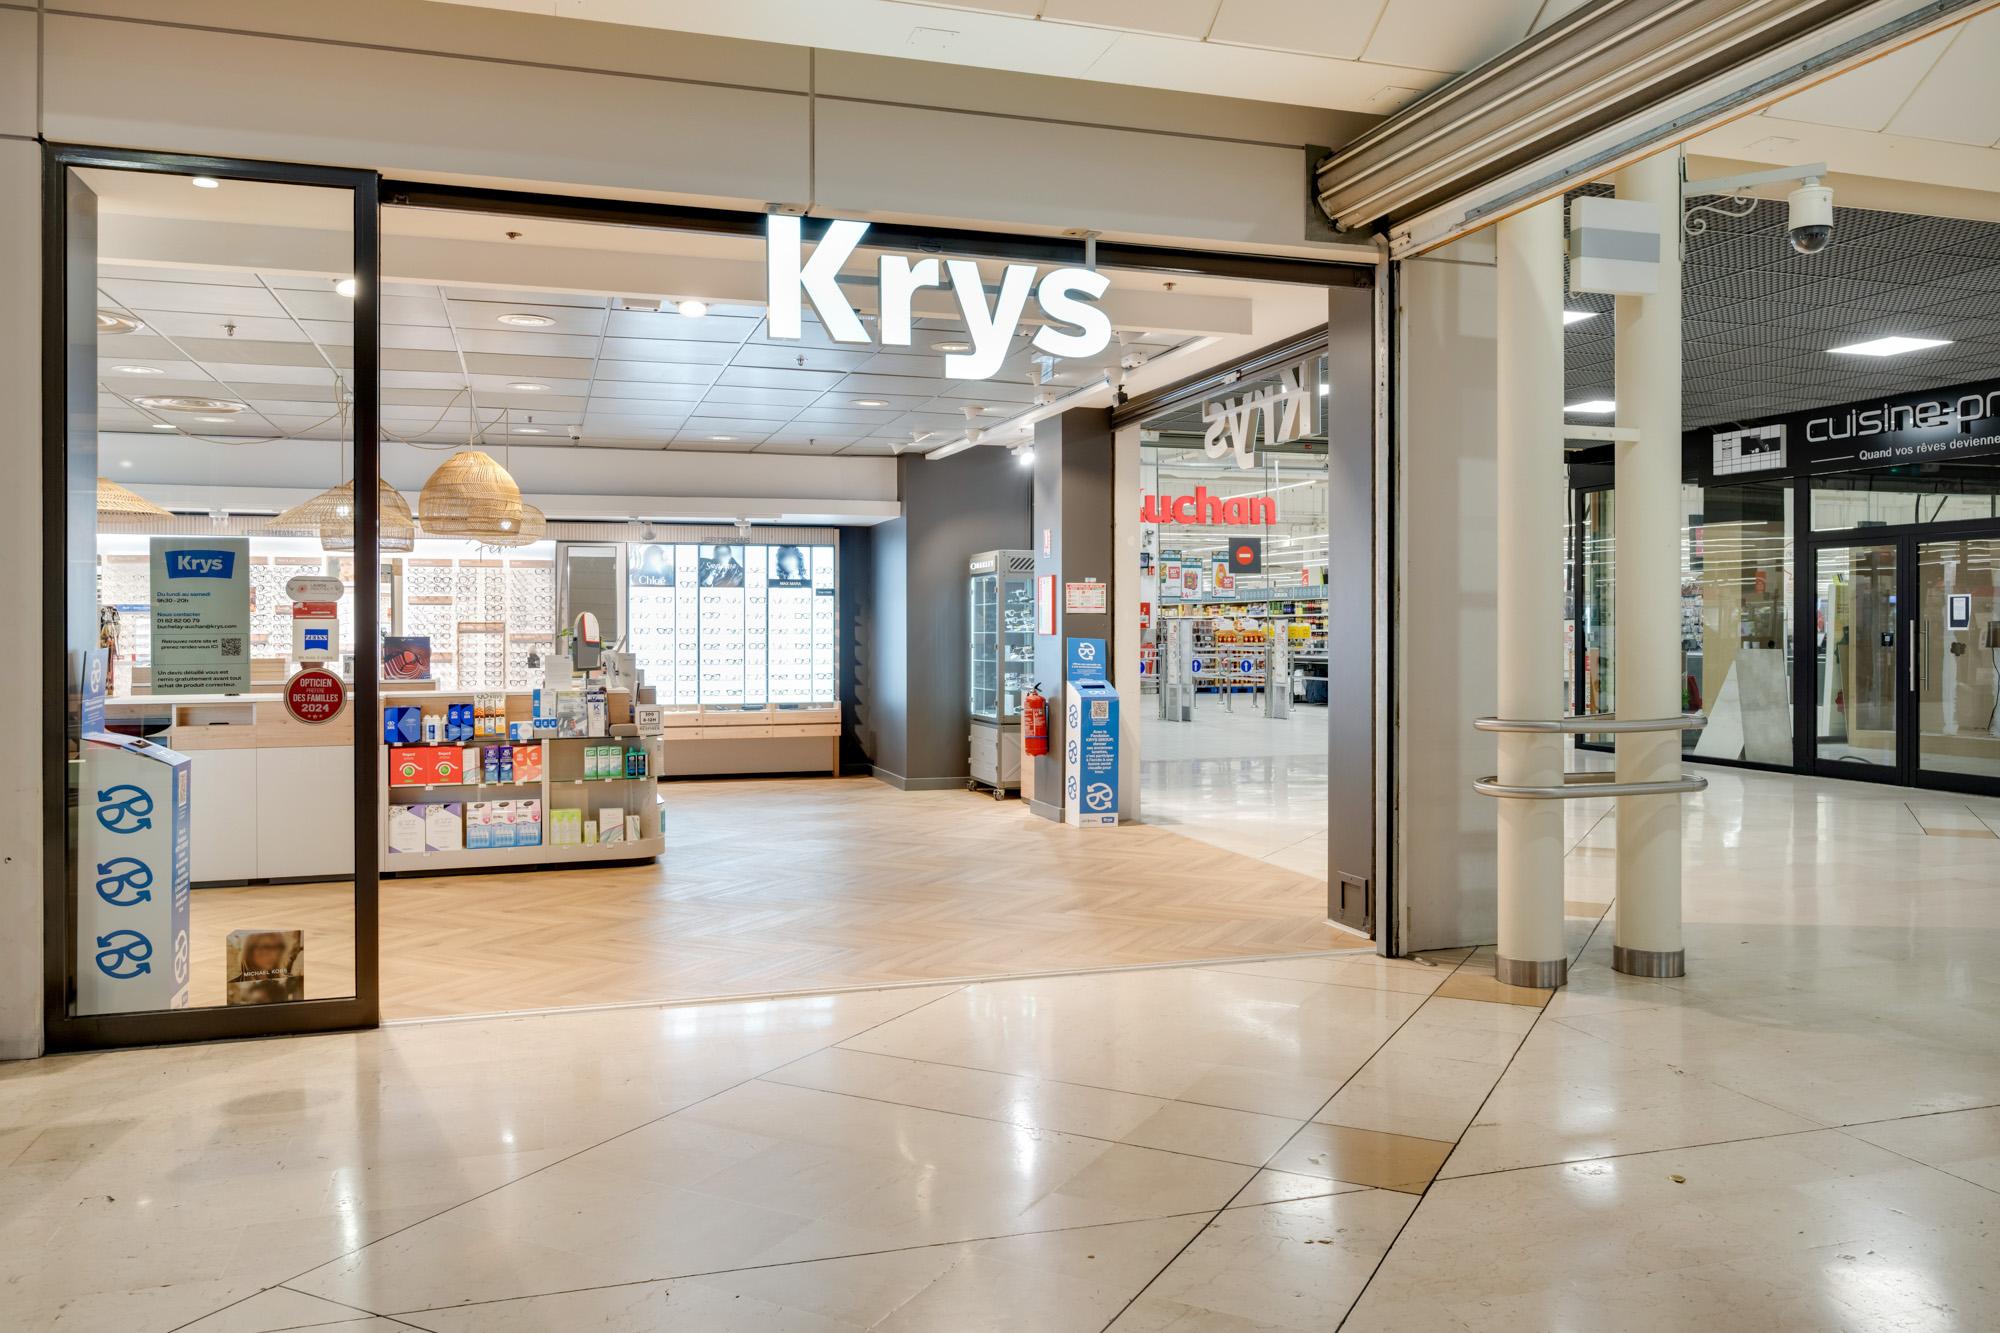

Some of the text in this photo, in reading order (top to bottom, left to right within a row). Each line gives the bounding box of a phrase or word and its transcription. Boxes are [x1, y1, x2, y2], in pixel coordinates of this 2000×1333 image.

[767, 215, 1112, 380] Krys
[1859, 447, 1892, 461] Quand
[1895, 445, 1913, 456] vos
[1916, 442, 1946, 453] rêves
[1140, 485, 1277, 525] uchan
[177, 555, 223, 574] Krys
[638, 575, 666, 585] Chloé
[300, 678, 333, 688] OPTICIEN
[293, 693, 339, 702] DES FAMILLES
[301, 703, 329, 713] 2024
